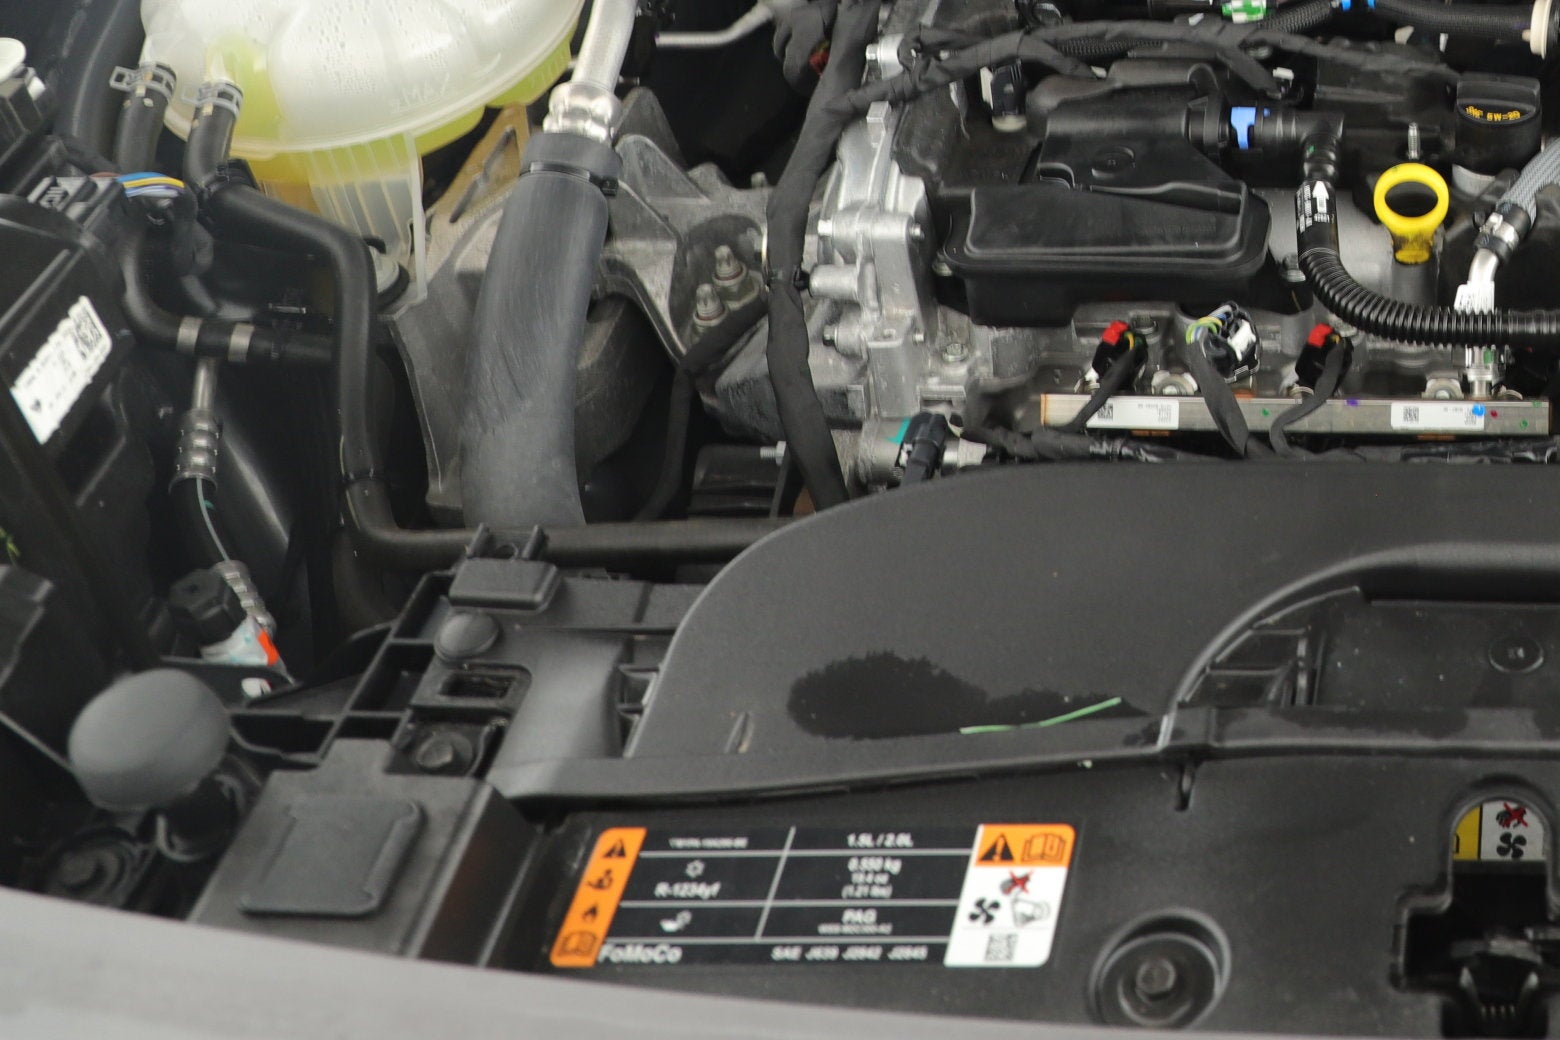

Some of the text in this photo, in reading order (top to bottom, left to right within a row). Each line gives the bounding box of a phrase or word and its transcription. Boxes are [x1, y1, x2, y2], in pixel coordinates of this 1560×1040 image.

[654, 881, 721, 900] R-1234yf
[598, 944, 683, 964] FoMoCo
[771, 946, 802, 960] SAE
